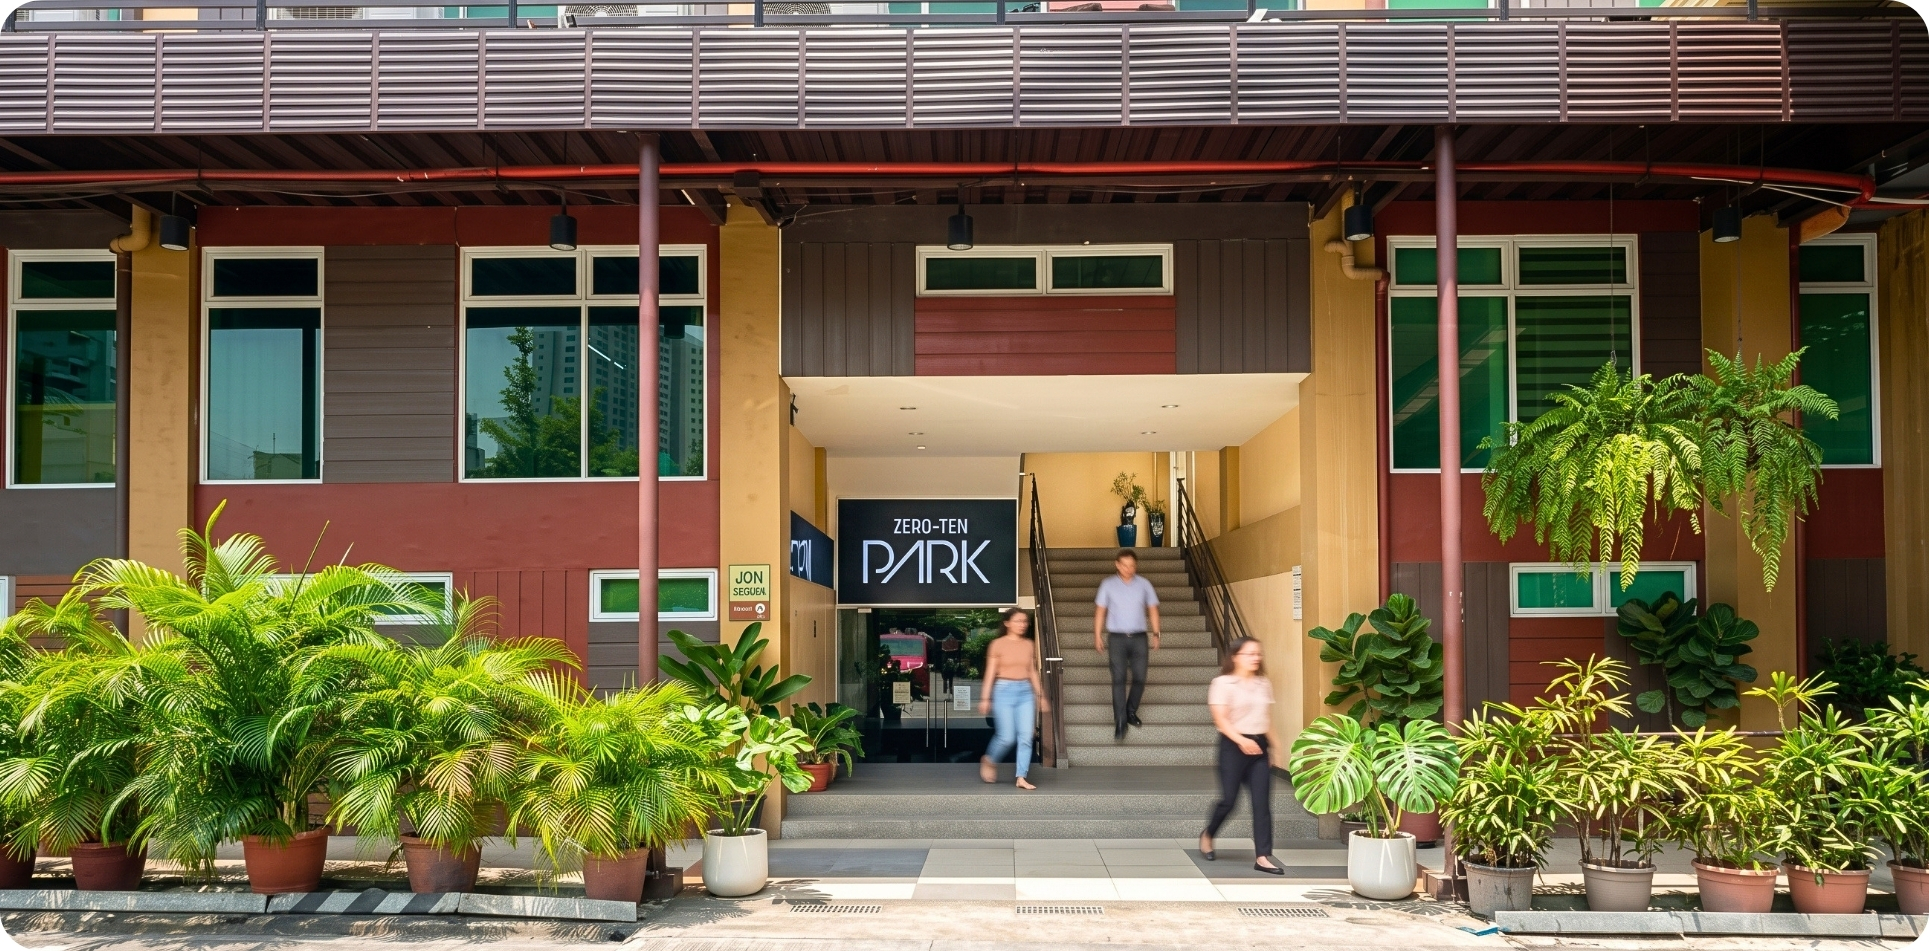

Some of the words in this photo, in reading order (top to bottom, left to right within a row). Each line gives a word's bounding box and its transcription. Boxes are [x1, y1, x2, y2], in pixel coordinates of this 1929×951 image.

[893, 518, 968, 534] ZERO-TEN
[862, 539, 992, 584] PARK
[735, 570, 763, 584] JON
